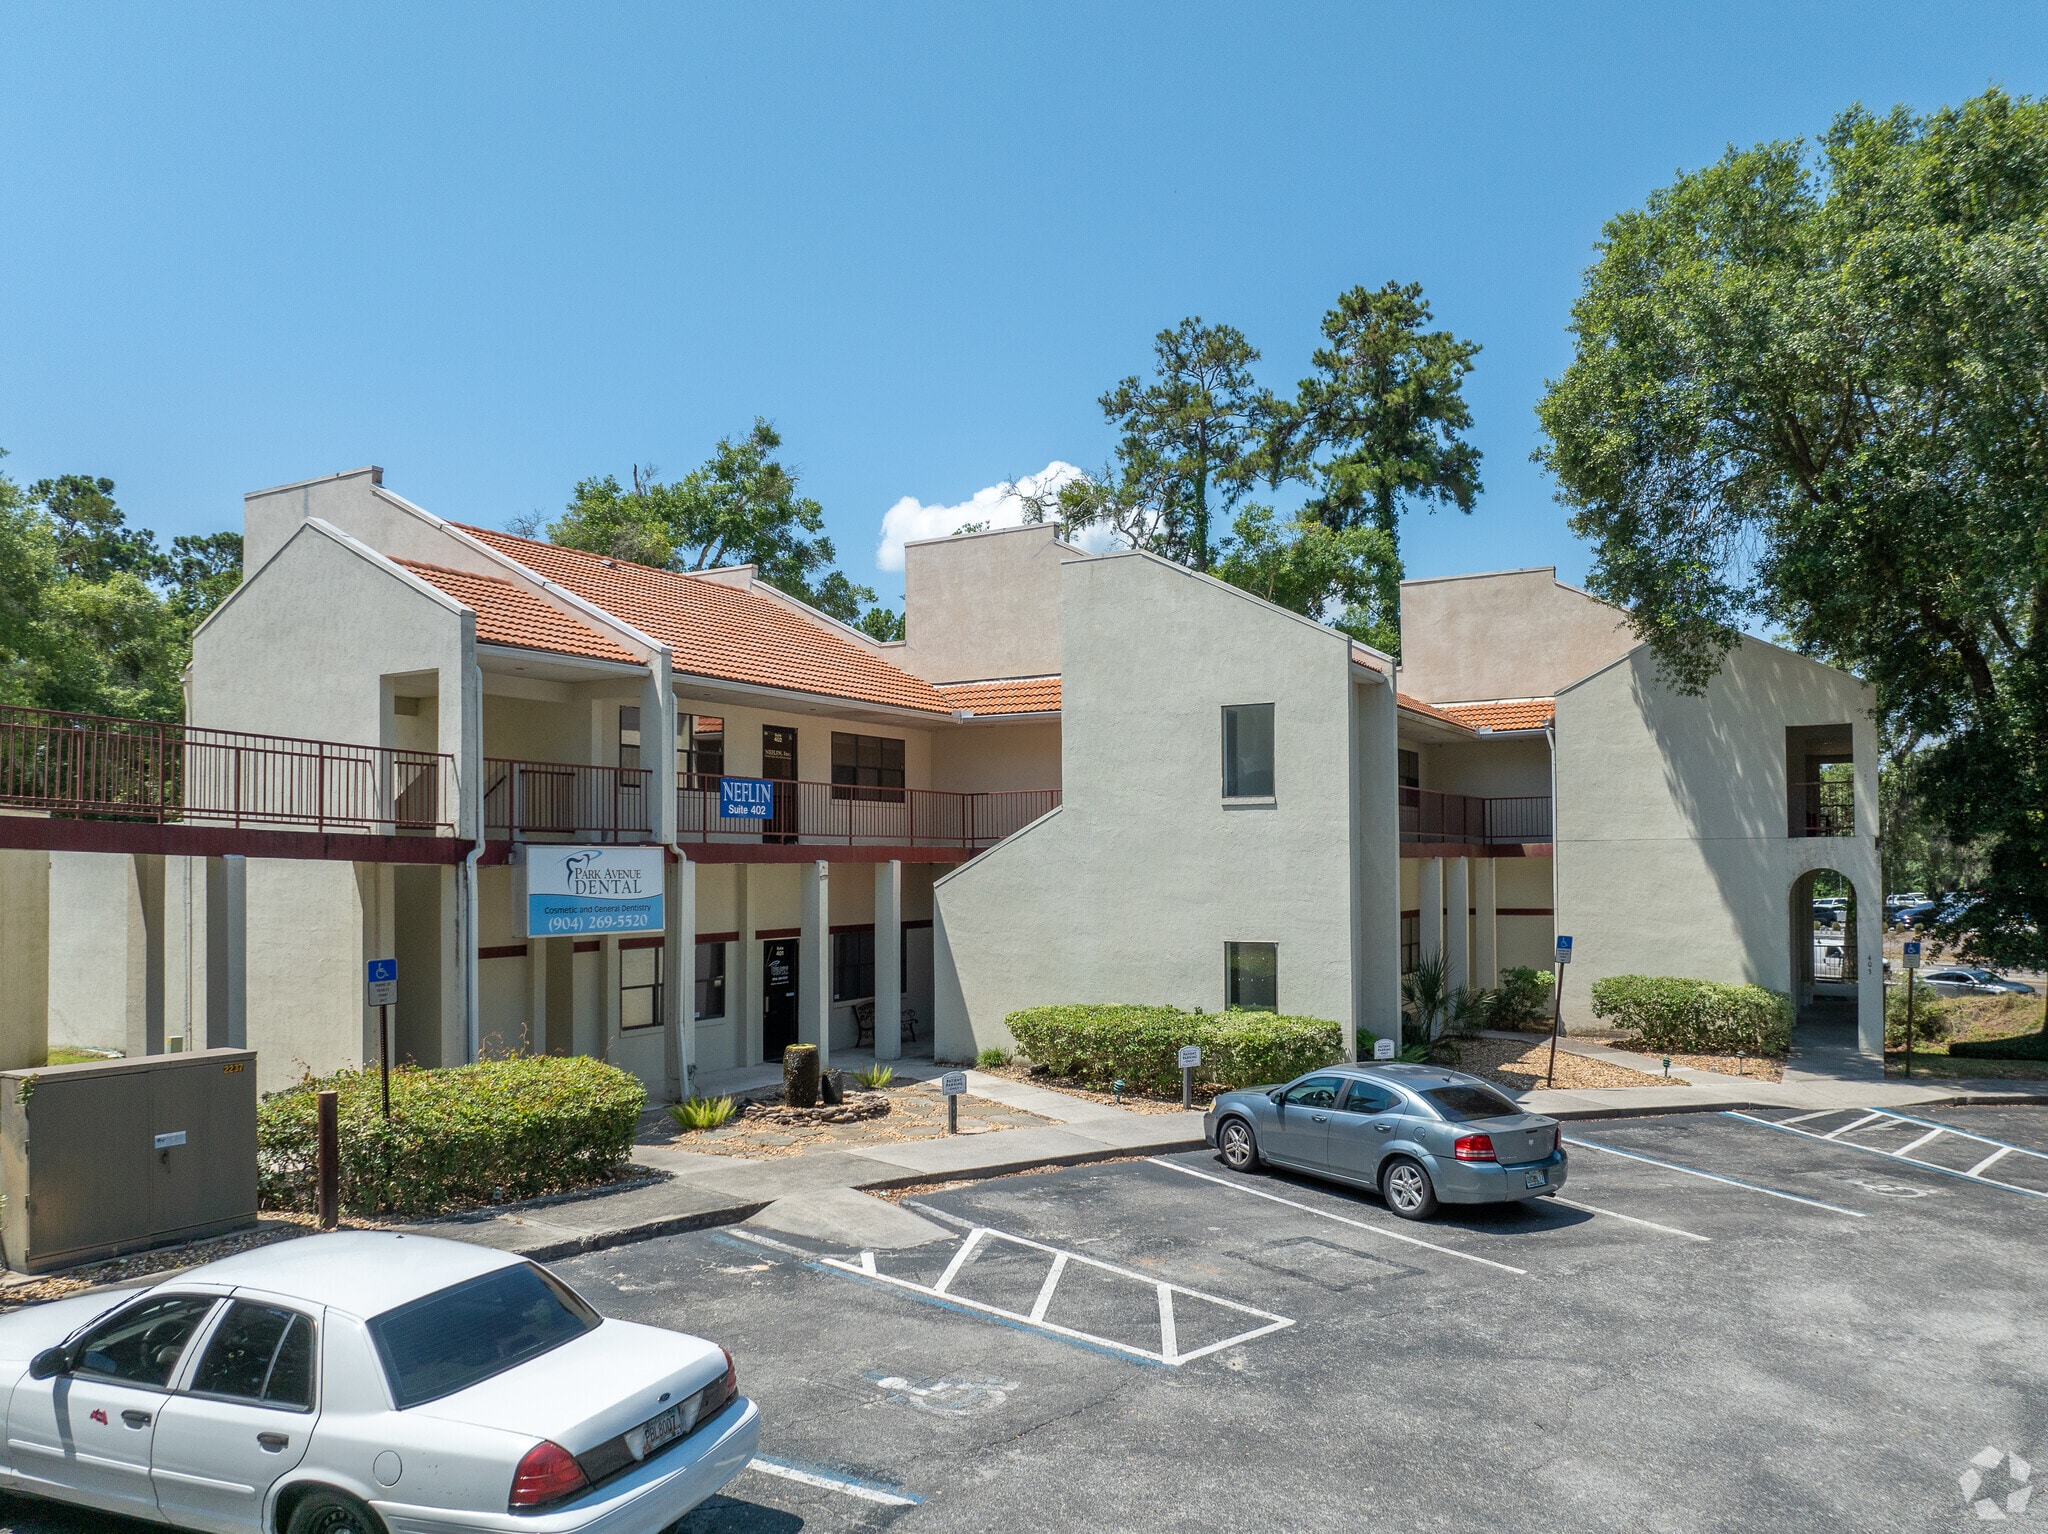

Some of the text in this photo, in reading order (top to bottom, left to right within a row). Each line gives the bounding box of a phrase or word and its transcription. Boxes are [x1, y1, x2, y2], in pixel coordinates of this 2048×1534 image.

[722, 781, 772, 803] NEFLIN
[728, 804, 766, 815] Suite 402
[574, 867, 642, 879] PARK AVENUE
[575, 879, 642, 895] DENTAL
[544, 904, 651, 915] Cosmetic and General Dentistry
[548, 914, 648, 933] (904) 269-5520
[223, 1063, 244, 1074] 2237
